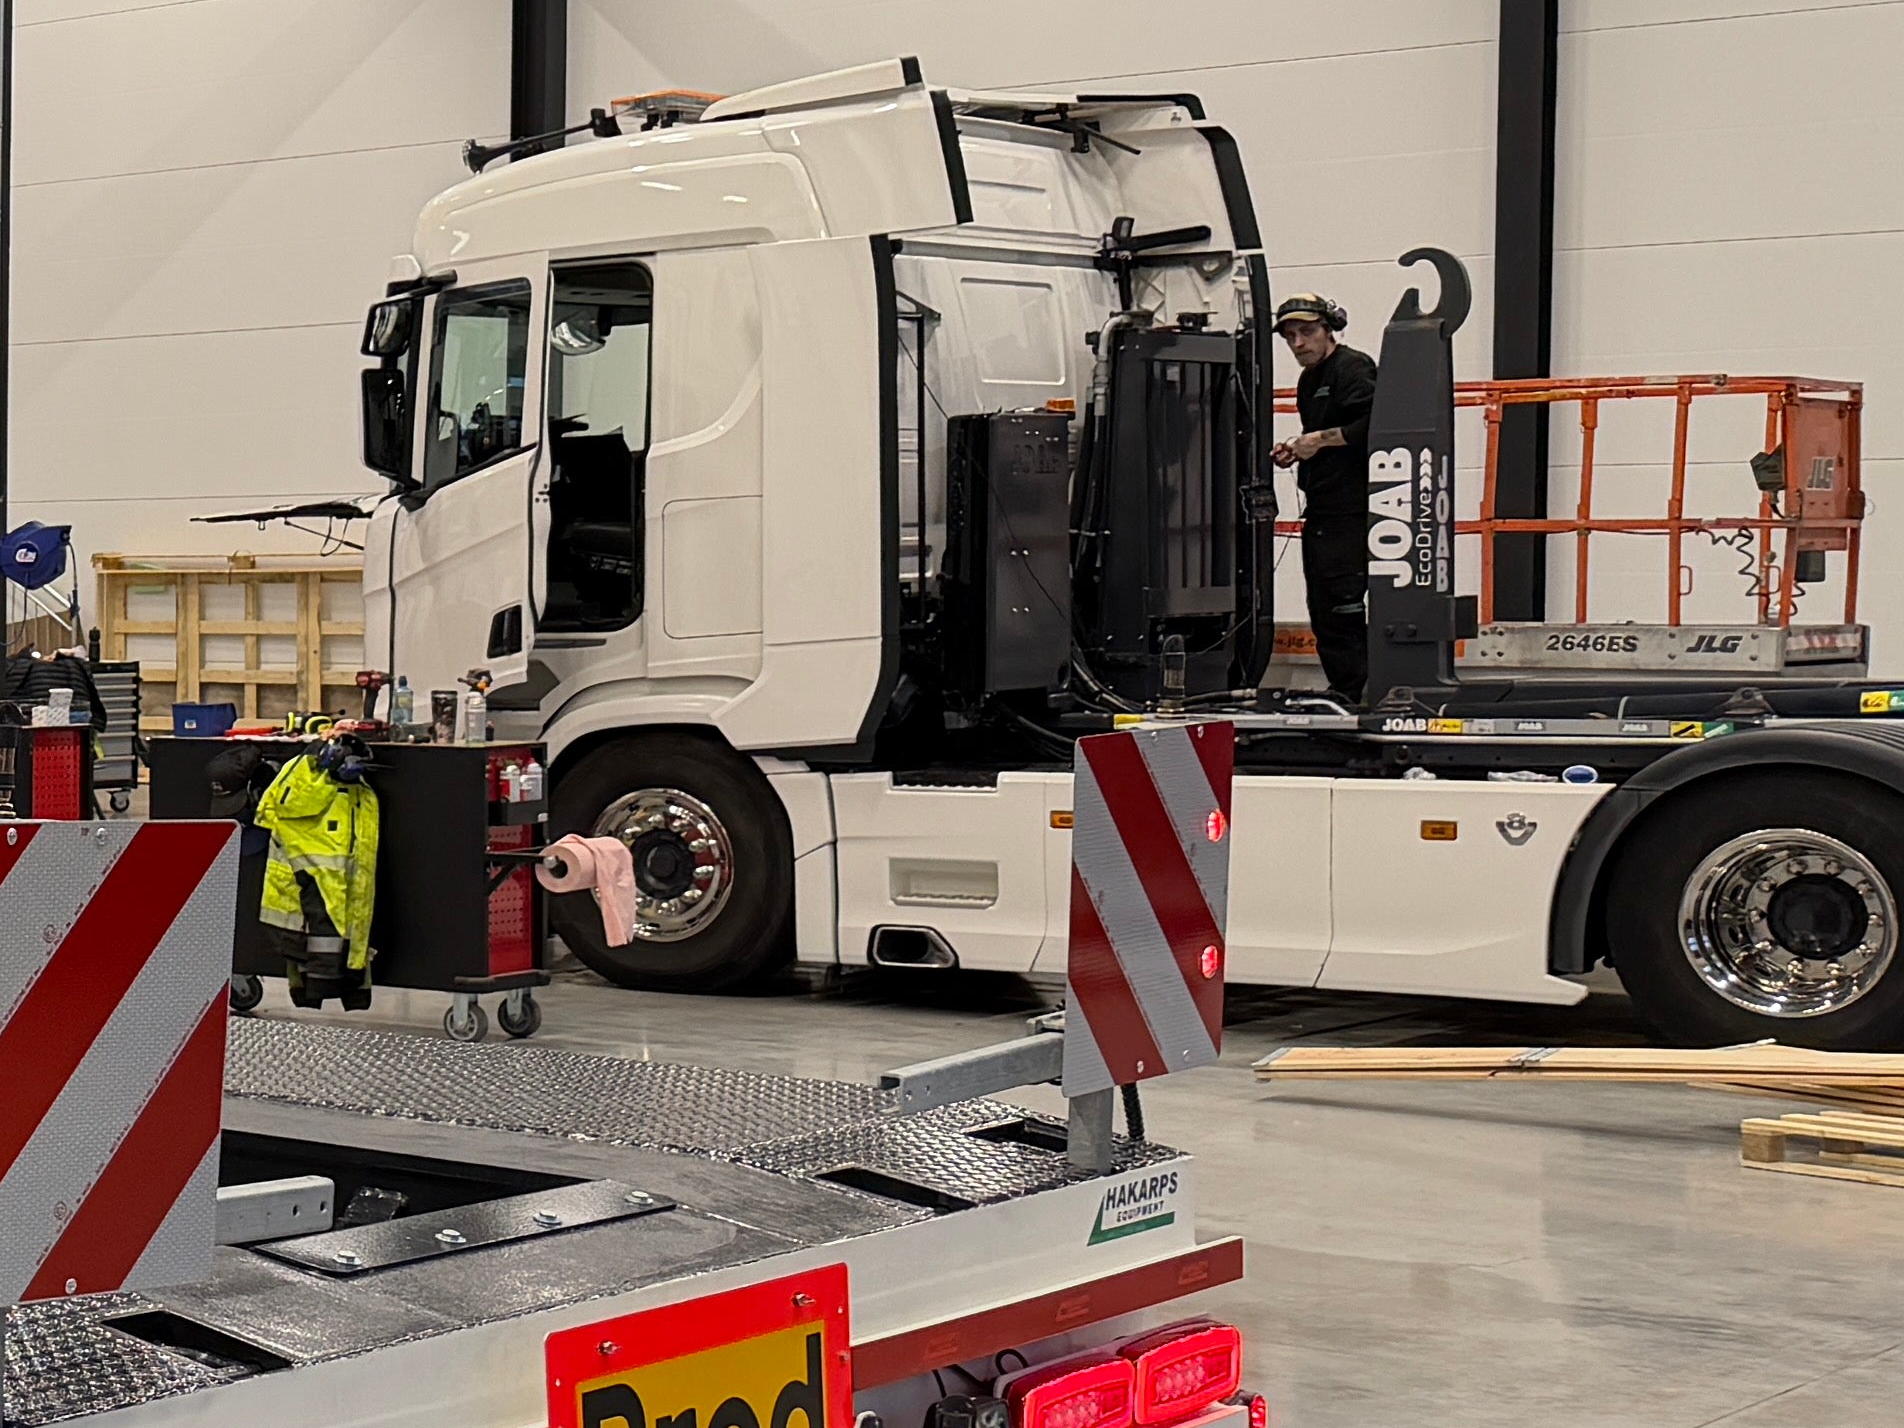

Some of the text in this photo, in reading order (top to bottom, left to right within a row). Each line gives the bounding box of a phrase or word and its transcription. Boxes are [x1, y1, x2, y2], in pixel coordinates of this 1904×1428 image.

[1806, 457, 1834, 489] JLG
[1367, 446, 1414, 588] JOAB
[1435, 454, 1451, 593] JOAB
[1415, 492, 1433, 587] EcoDrive
[1545, 634, 1640, 653] 2646ES
[1686, 635, 1743, 653] JLG
[1382, 718, 1428, 732] JOAB
[1105, 1171, 1178, 1211] HAKARPS
[1116, 1200, 1165, 1223] EQUIPMENT
